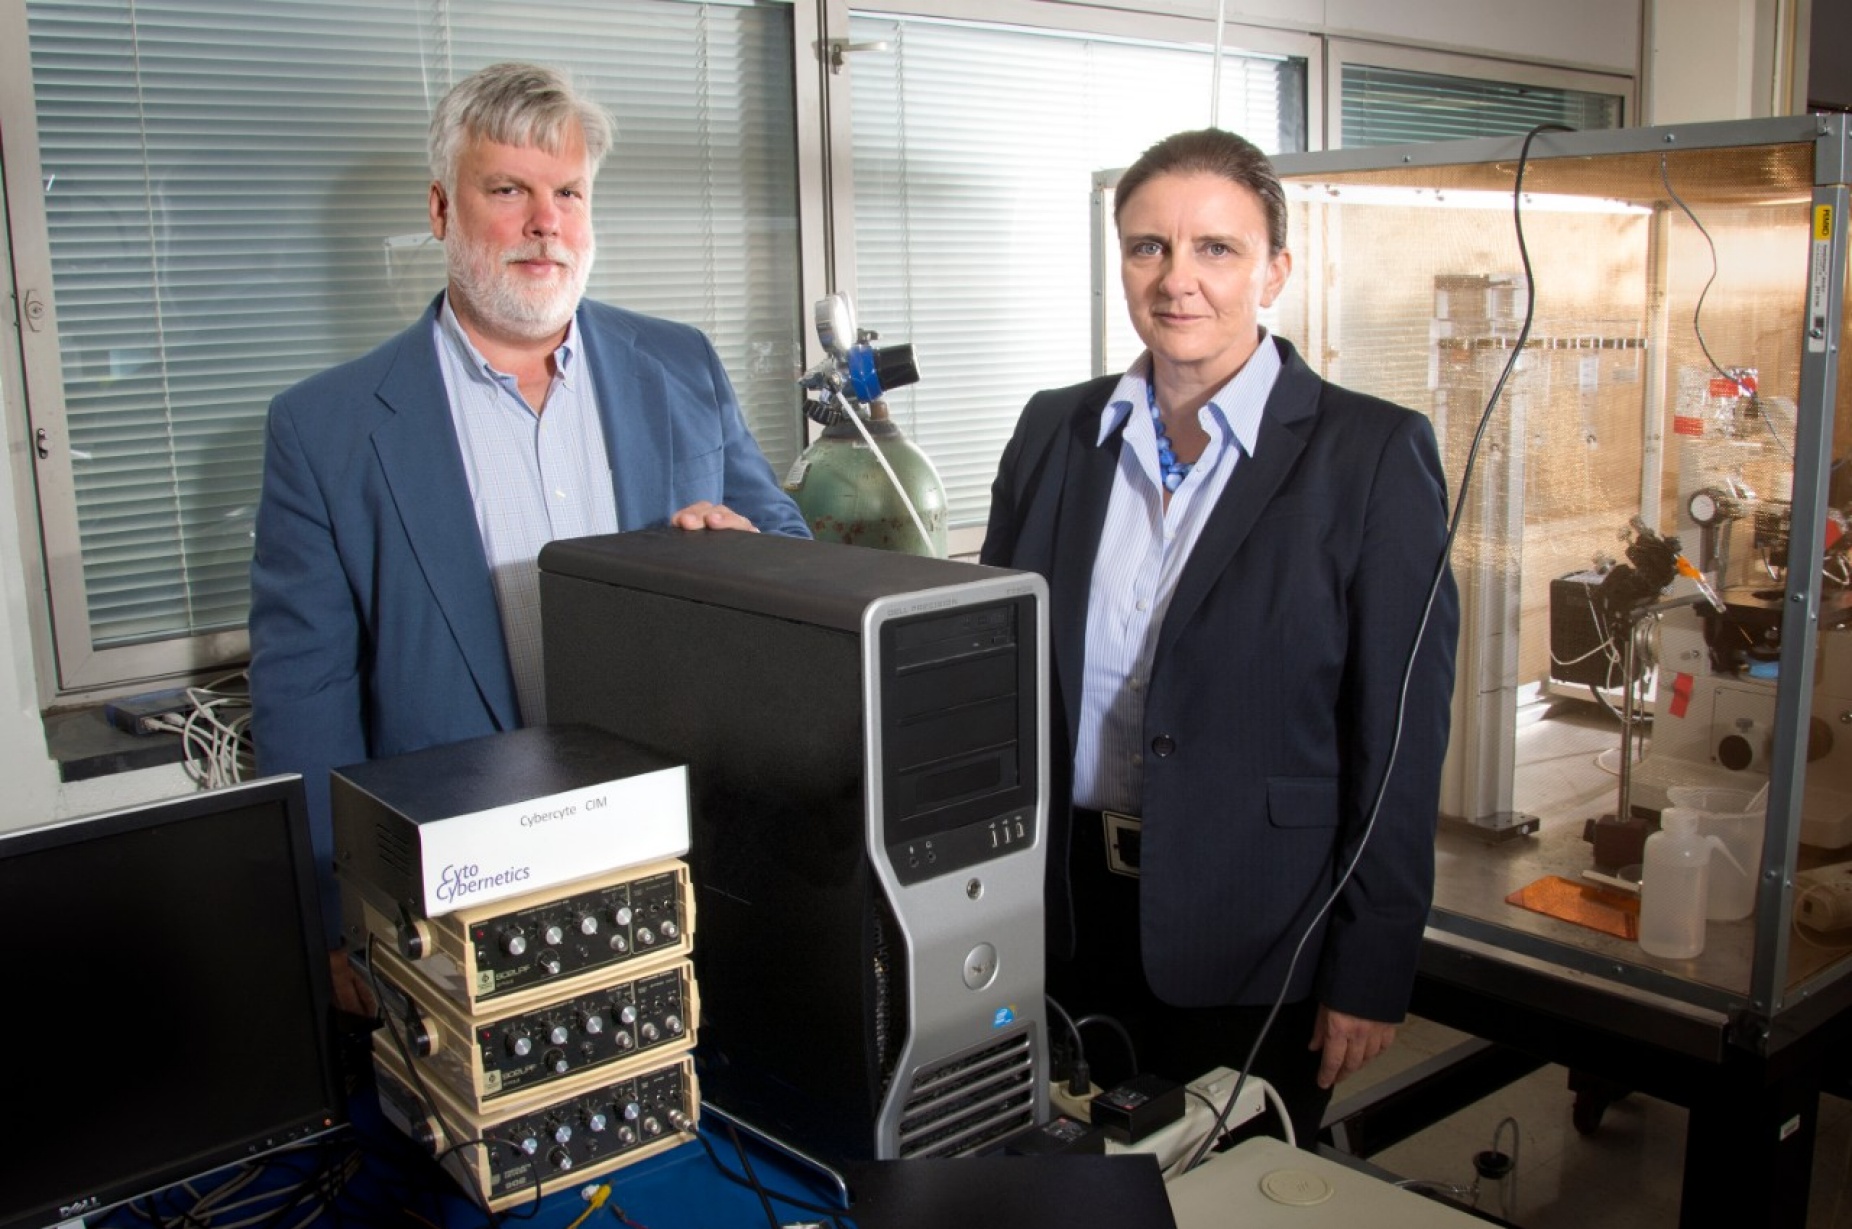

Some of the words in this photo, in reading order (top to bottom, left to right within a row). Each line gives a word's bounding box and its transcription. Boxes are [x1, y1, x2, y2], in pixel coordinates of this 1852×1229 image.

[520, 805, 577, 828] Cybercyte
[585, 796, 608, 812] CIM
[436, 866, 531, 903] Cybernetics
[441, 863, 479, 886] Cyto
[60, 1196, 100, 1218] DELL
